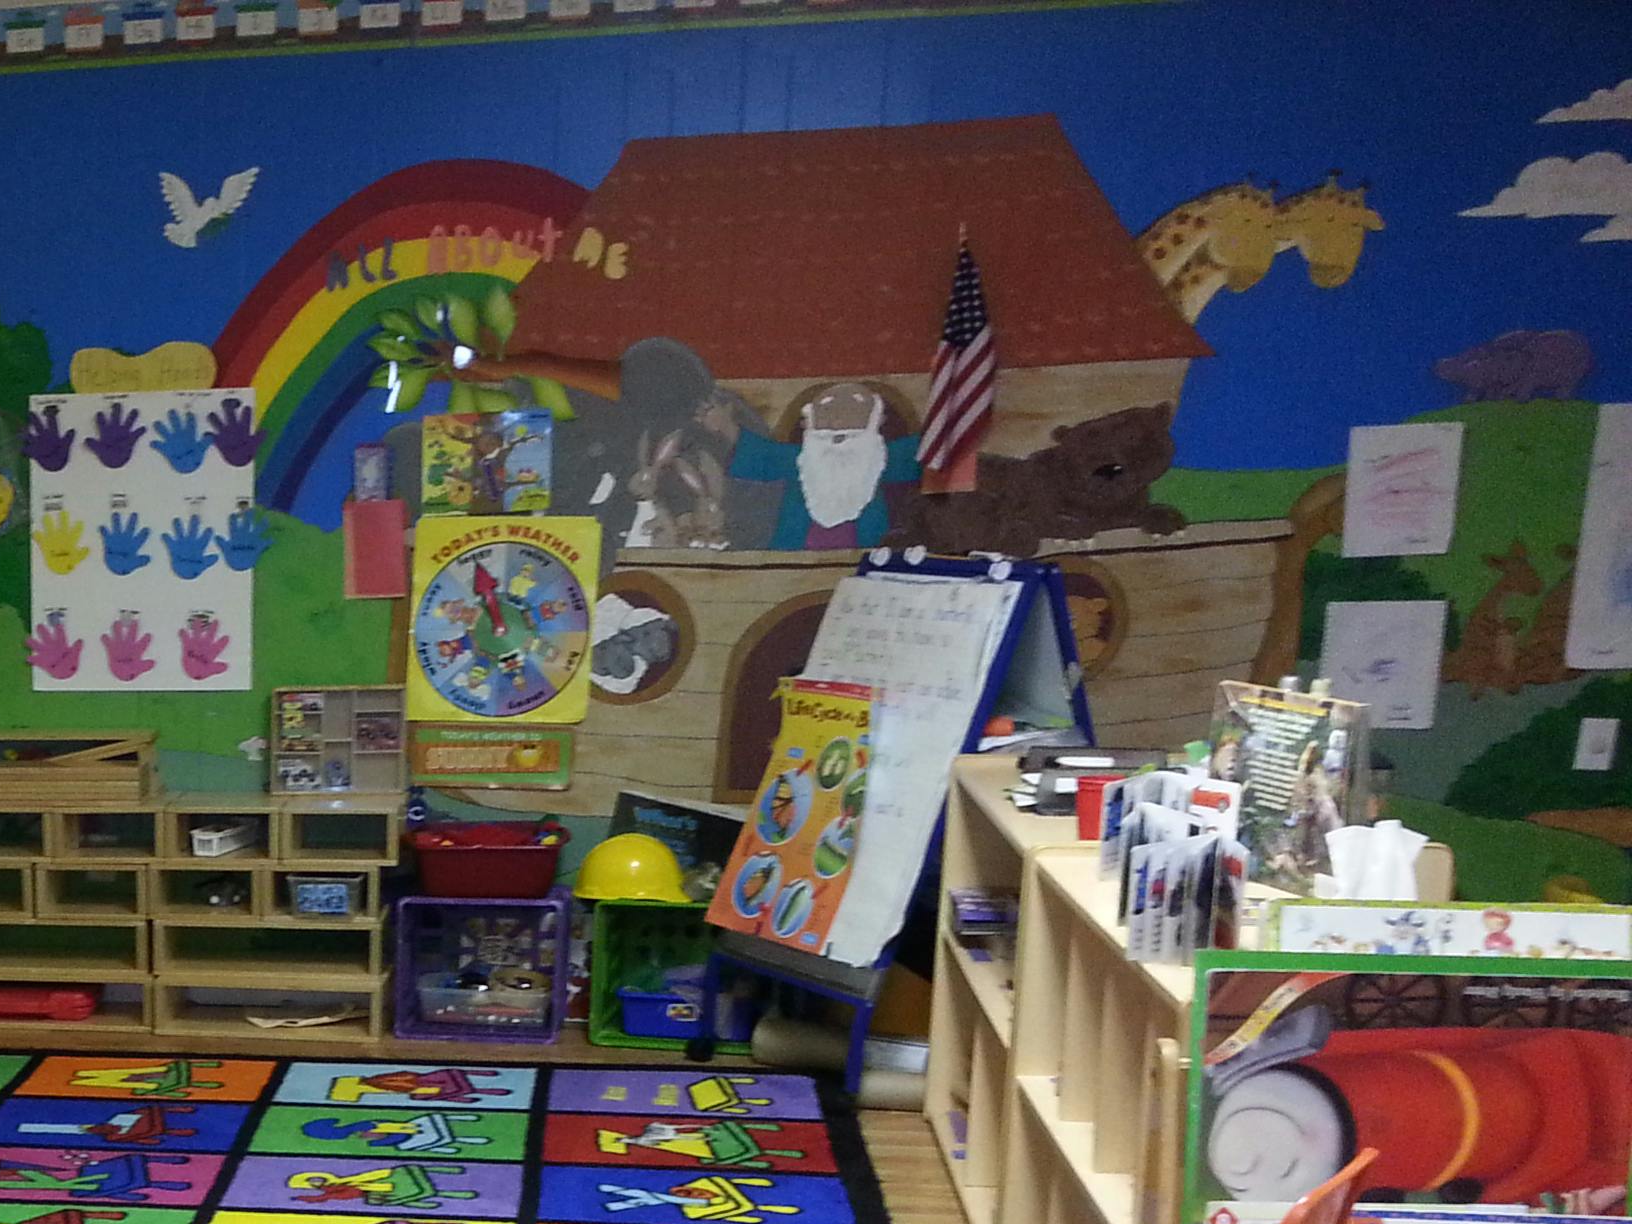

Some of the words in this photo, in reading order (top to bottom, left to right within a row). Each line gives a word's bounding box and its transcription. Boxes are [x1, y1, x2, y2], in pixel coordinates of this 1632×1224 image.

[431, 524, 500, 564] TODAY'S
[507, 524, 581, 563] WEATHER
[328, 1075, 441, 1102] T
